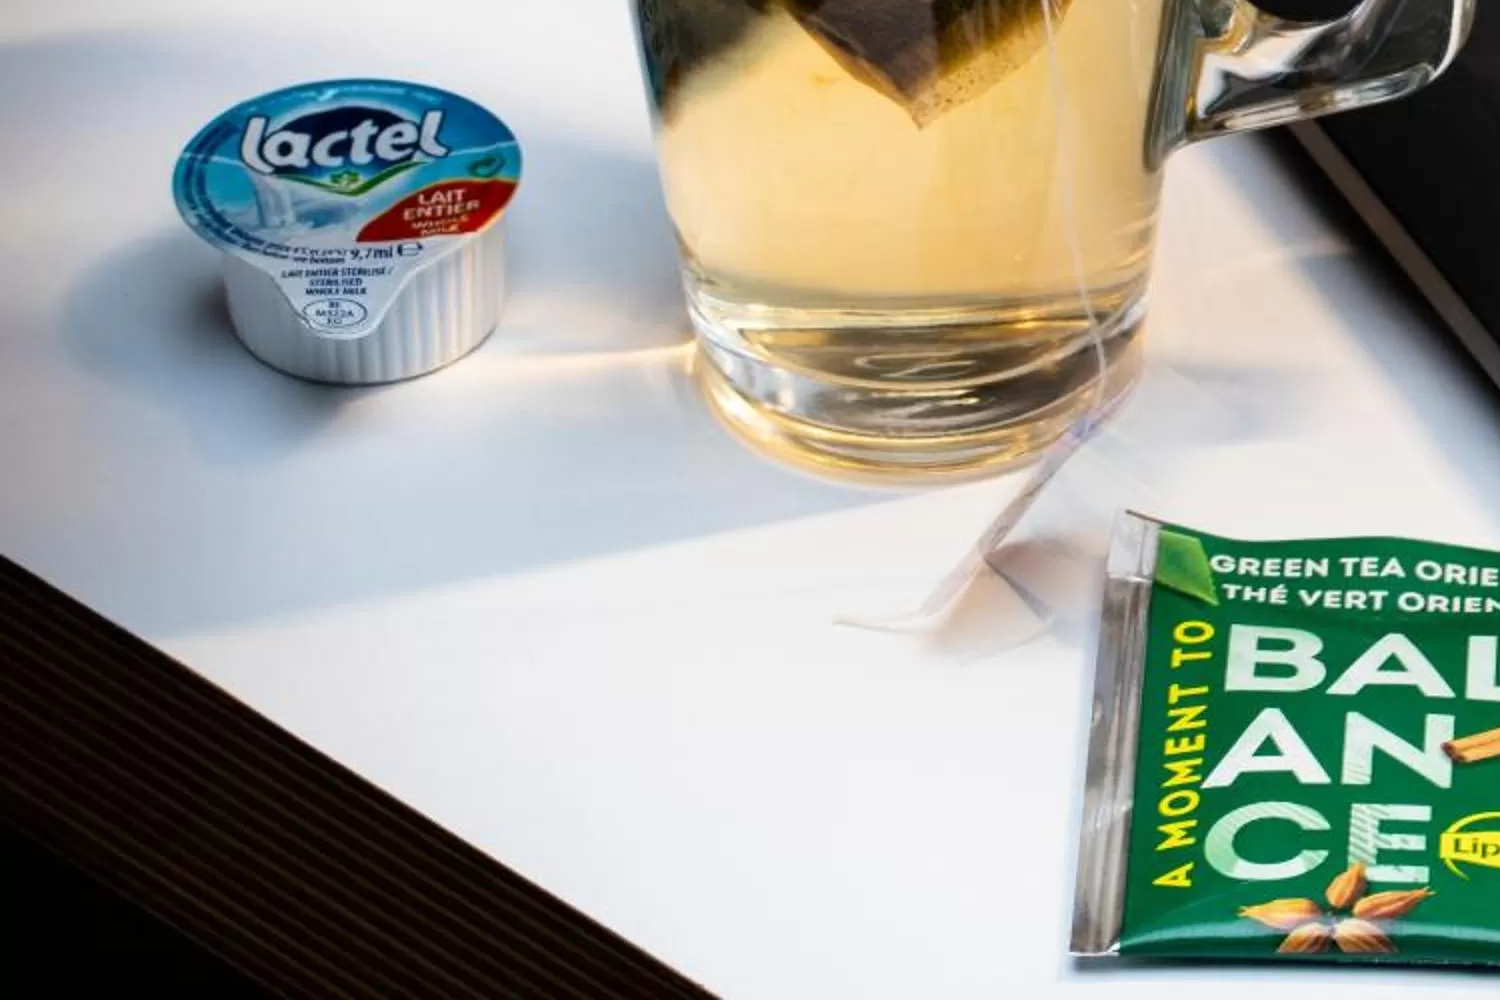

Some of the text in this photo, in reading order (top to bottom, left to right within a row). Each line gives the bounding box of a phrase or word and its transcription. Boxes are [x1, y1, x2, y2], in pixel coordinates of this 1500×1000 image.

[241, 110, 448, 175] lactel
[403, 200, 480, 221] ENTIER
[418, 188, 466, 205] LAIT
[1210, 554, 1329, 578] GREEN
[1339, 557, 1406, 579] TEA
[1221, 583, 1289, 605] THÉ
[1299, 589, 1389, 612] VERT
[1152, 620, 1216, 887] A MOMENT TO
[1200, 707, 1456, 789] AN
[1203, 801, 1433, 884] CE
